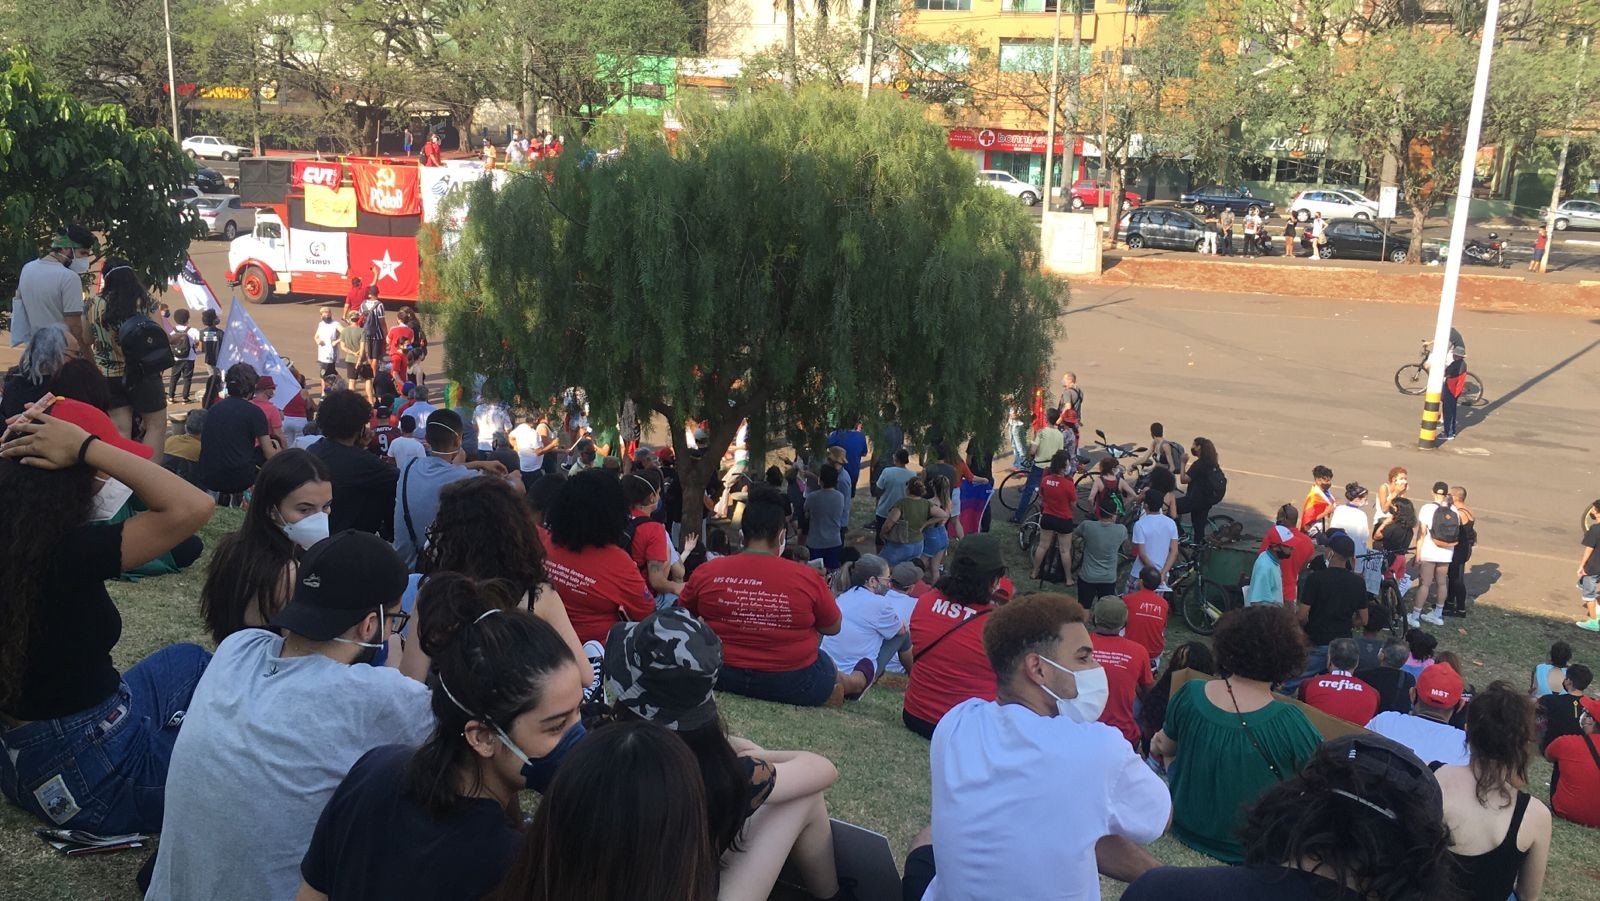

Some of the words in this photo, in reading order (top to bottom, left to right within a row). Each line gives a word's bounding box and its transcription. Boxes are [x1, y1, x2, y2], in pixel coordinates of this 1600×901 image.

[303, 166, 334, 185] CUT
[370, 187, 403, 209] PCdoB
[382, 262, 392, 272] PT
[378, 434, 388, 452] 9
[1046, 479, 1060, 487] MST
[931, 598, 977, 621] MST
[1139, 602, 1162, 616] MTM
[1318, 679, 1363, 691] crefisa
[1431, 688, 1449, 698] MST
